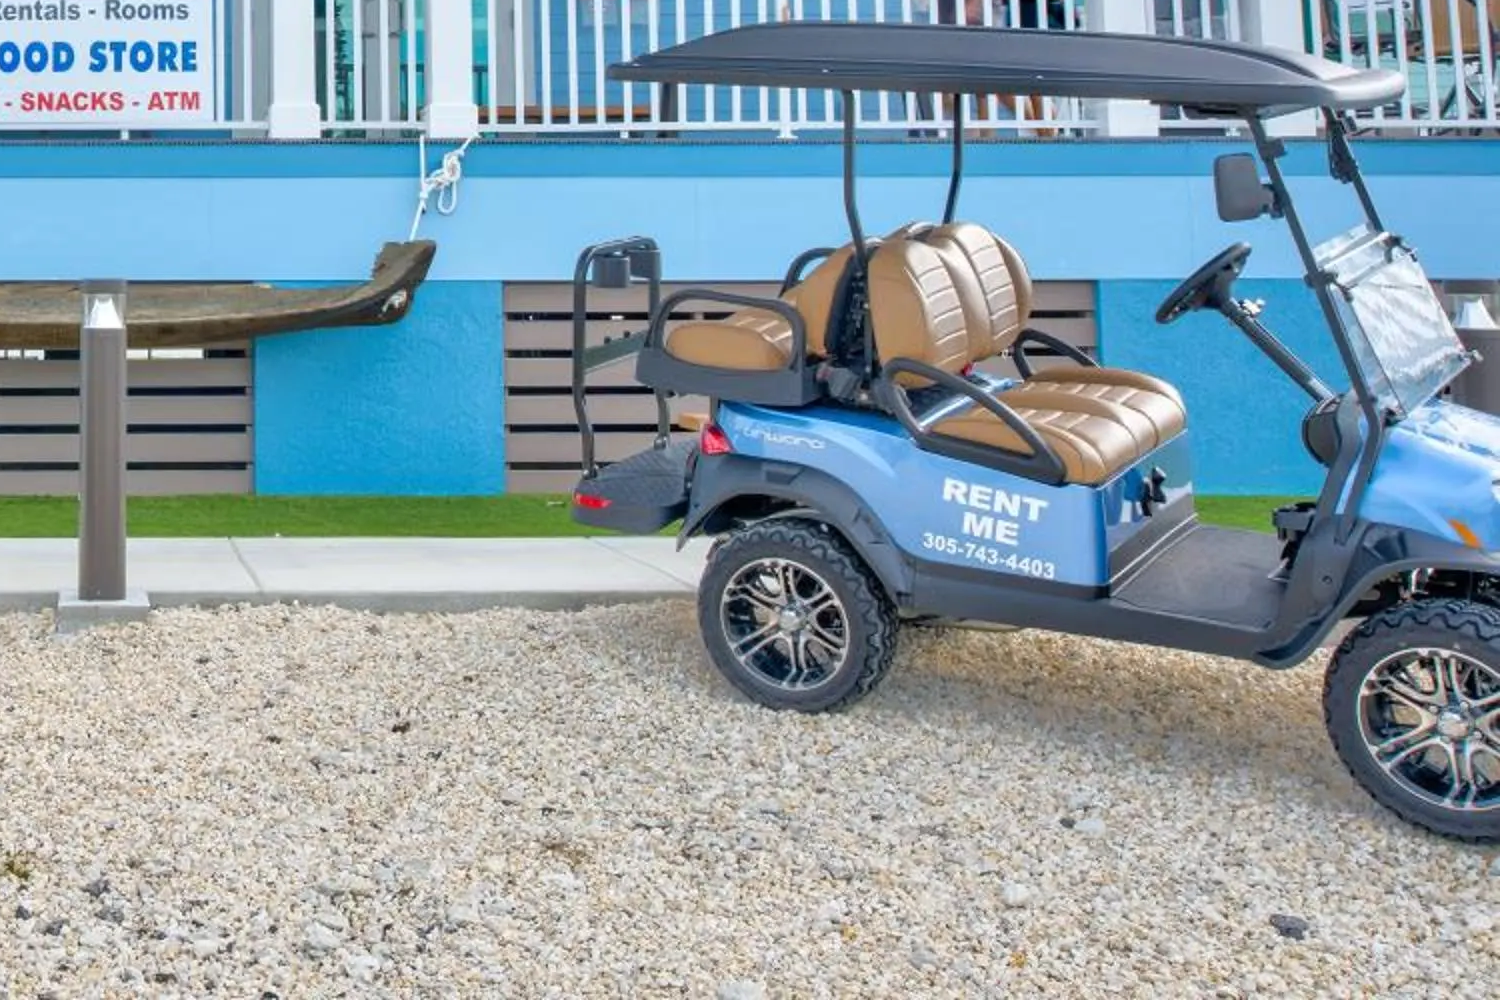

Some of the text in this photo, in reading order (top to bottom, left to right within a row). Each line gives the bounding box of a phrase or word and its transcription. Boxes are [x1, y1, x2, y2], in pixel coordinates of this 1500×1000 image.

[104, 0, 189, 20] Rooms
[88, 41, 198, 73] STORE
[20, 91, 125, 111] SNACKS
[147, 91, 200, 111] ATM
[942, 477, 1050, 522] RENT
[962, 511, 1019, 547] ME
[923, 532, 1056, 580] 305-743-4403
